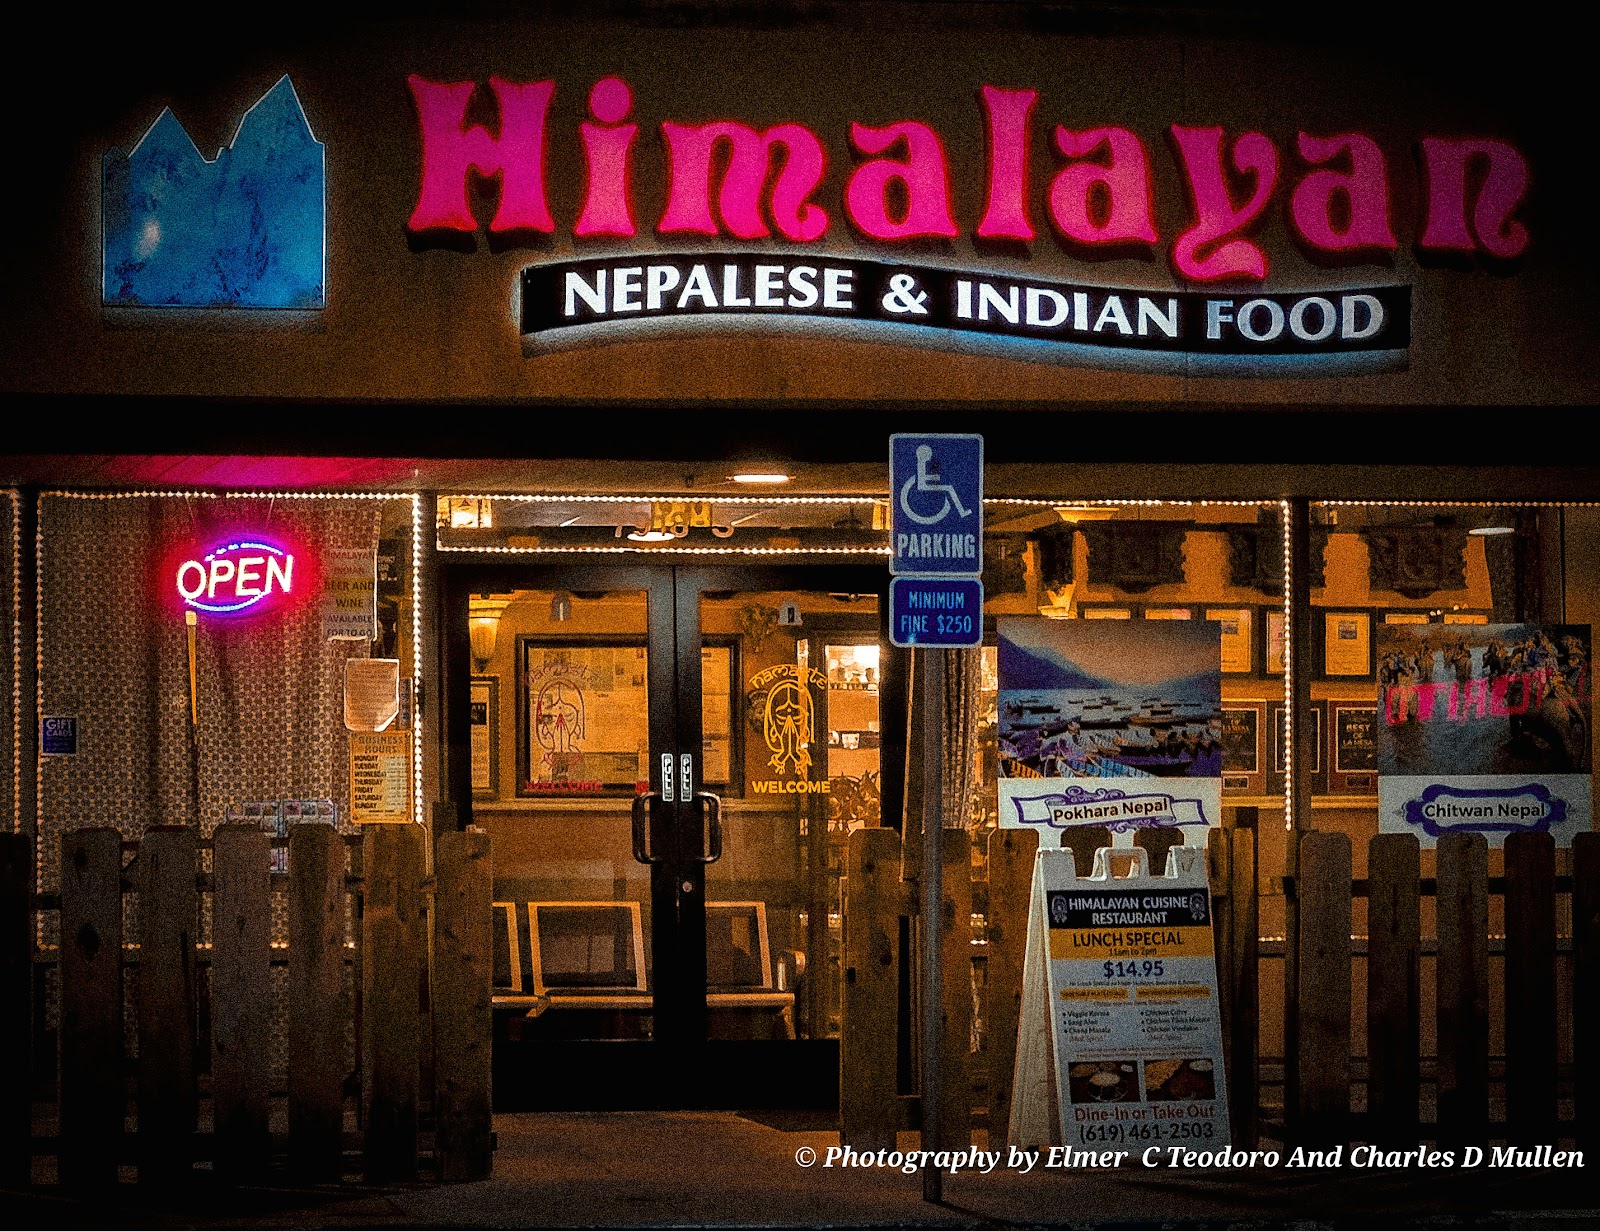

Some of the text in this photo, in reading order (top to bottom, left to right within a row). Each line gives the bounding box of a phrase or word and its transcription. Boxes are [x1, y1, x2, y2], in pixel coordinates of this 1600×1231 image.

[406, 74, 1533, 280] Himalayan
[563, 264, 1385, 342] NEPALESE & INDIAN FOOD
[897, 532, 976, 559] PARKING
[175, 552, 294, 600] OPEN
[352, 581, 374, 591] AND
[335, 599, 364, 608] WINE
[908, 591, 965, 609] MINIMUM
[901, 613, 973, 635] FINE $250
[45, 718, 73, 730] GIFT
[664, 758, 672, 790] PULL
[751, 780, 831, 794] WELCOME
[1053, 797, 1168, 822] Pokhara Nepal
[1424, 803, 1546, 820] Chitwan Nepal
[1068, 896, 1189, 911] HIMALAYAN CUISINE
[1091, 911, 1168, 925] RESTAURANT
[1073, 931, 1184, 948] LUNCH SPECIAL
[1103, 960, 1164, 978] $14.95
[1075, 1104, 1215, 1122] Dine-In or Take Out
[1079, 1122, 1214, 1143] (619) 461-2503
